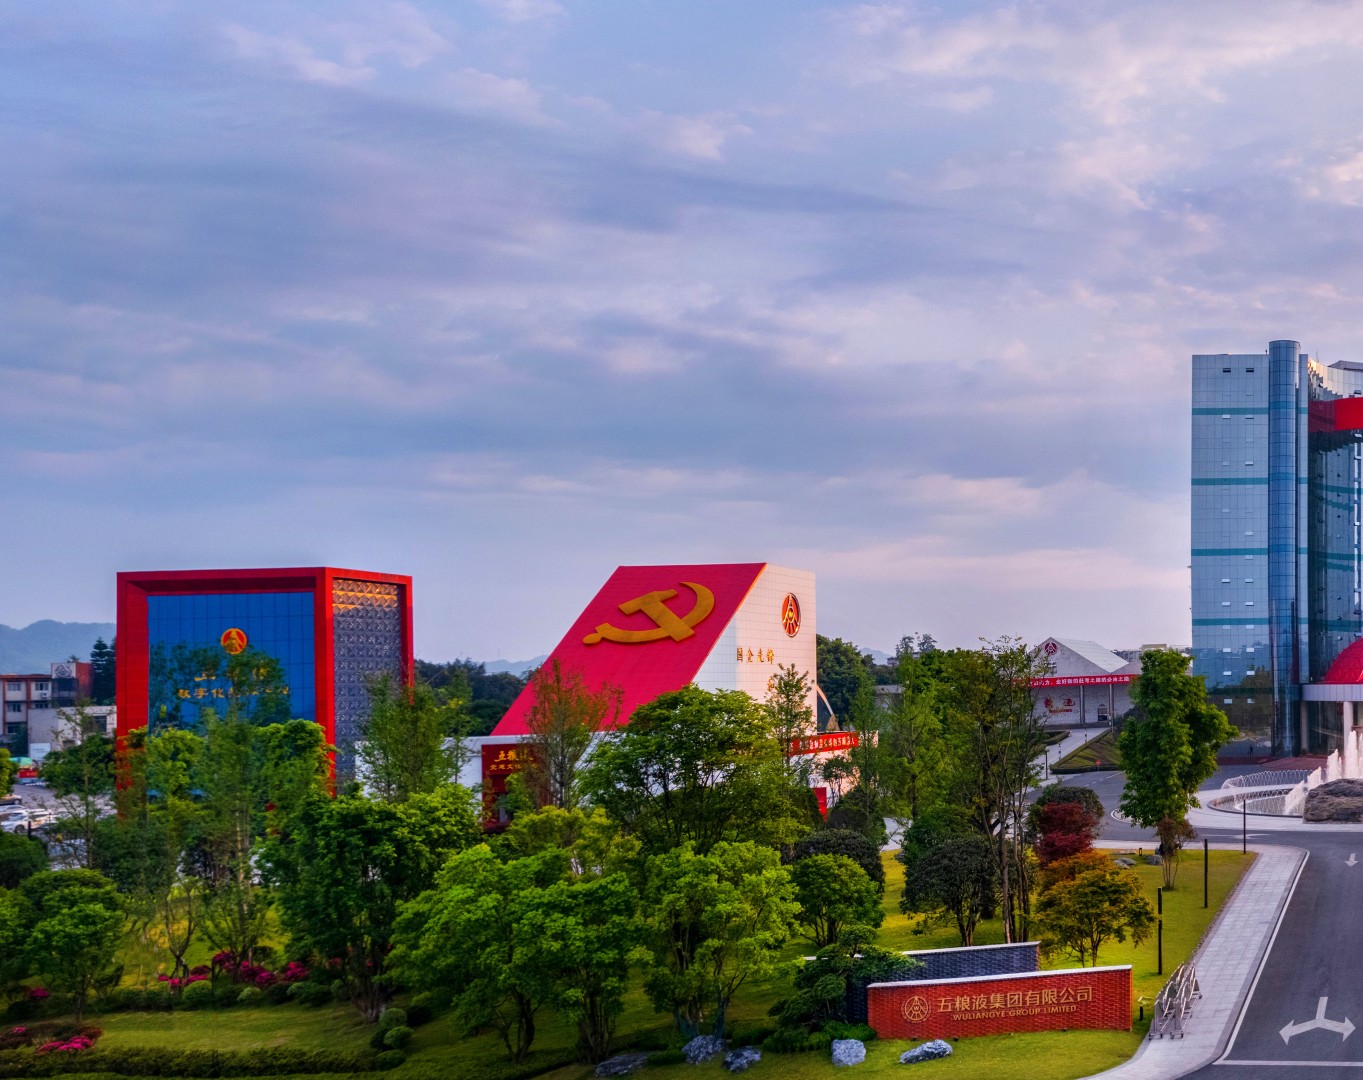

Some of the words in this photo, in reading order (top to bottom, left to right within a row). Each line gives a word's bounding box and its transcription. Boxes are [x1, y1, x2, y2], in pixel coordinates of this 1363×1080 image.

[936, 986, 1094, 1013] 五粮液集团有限公司
[952, 1010, 1006, 1021] WULIANGYE
[1008, 1008, 1041, 1017] GROUP
[1043, 1005, 1077, 1014] LIMITED
